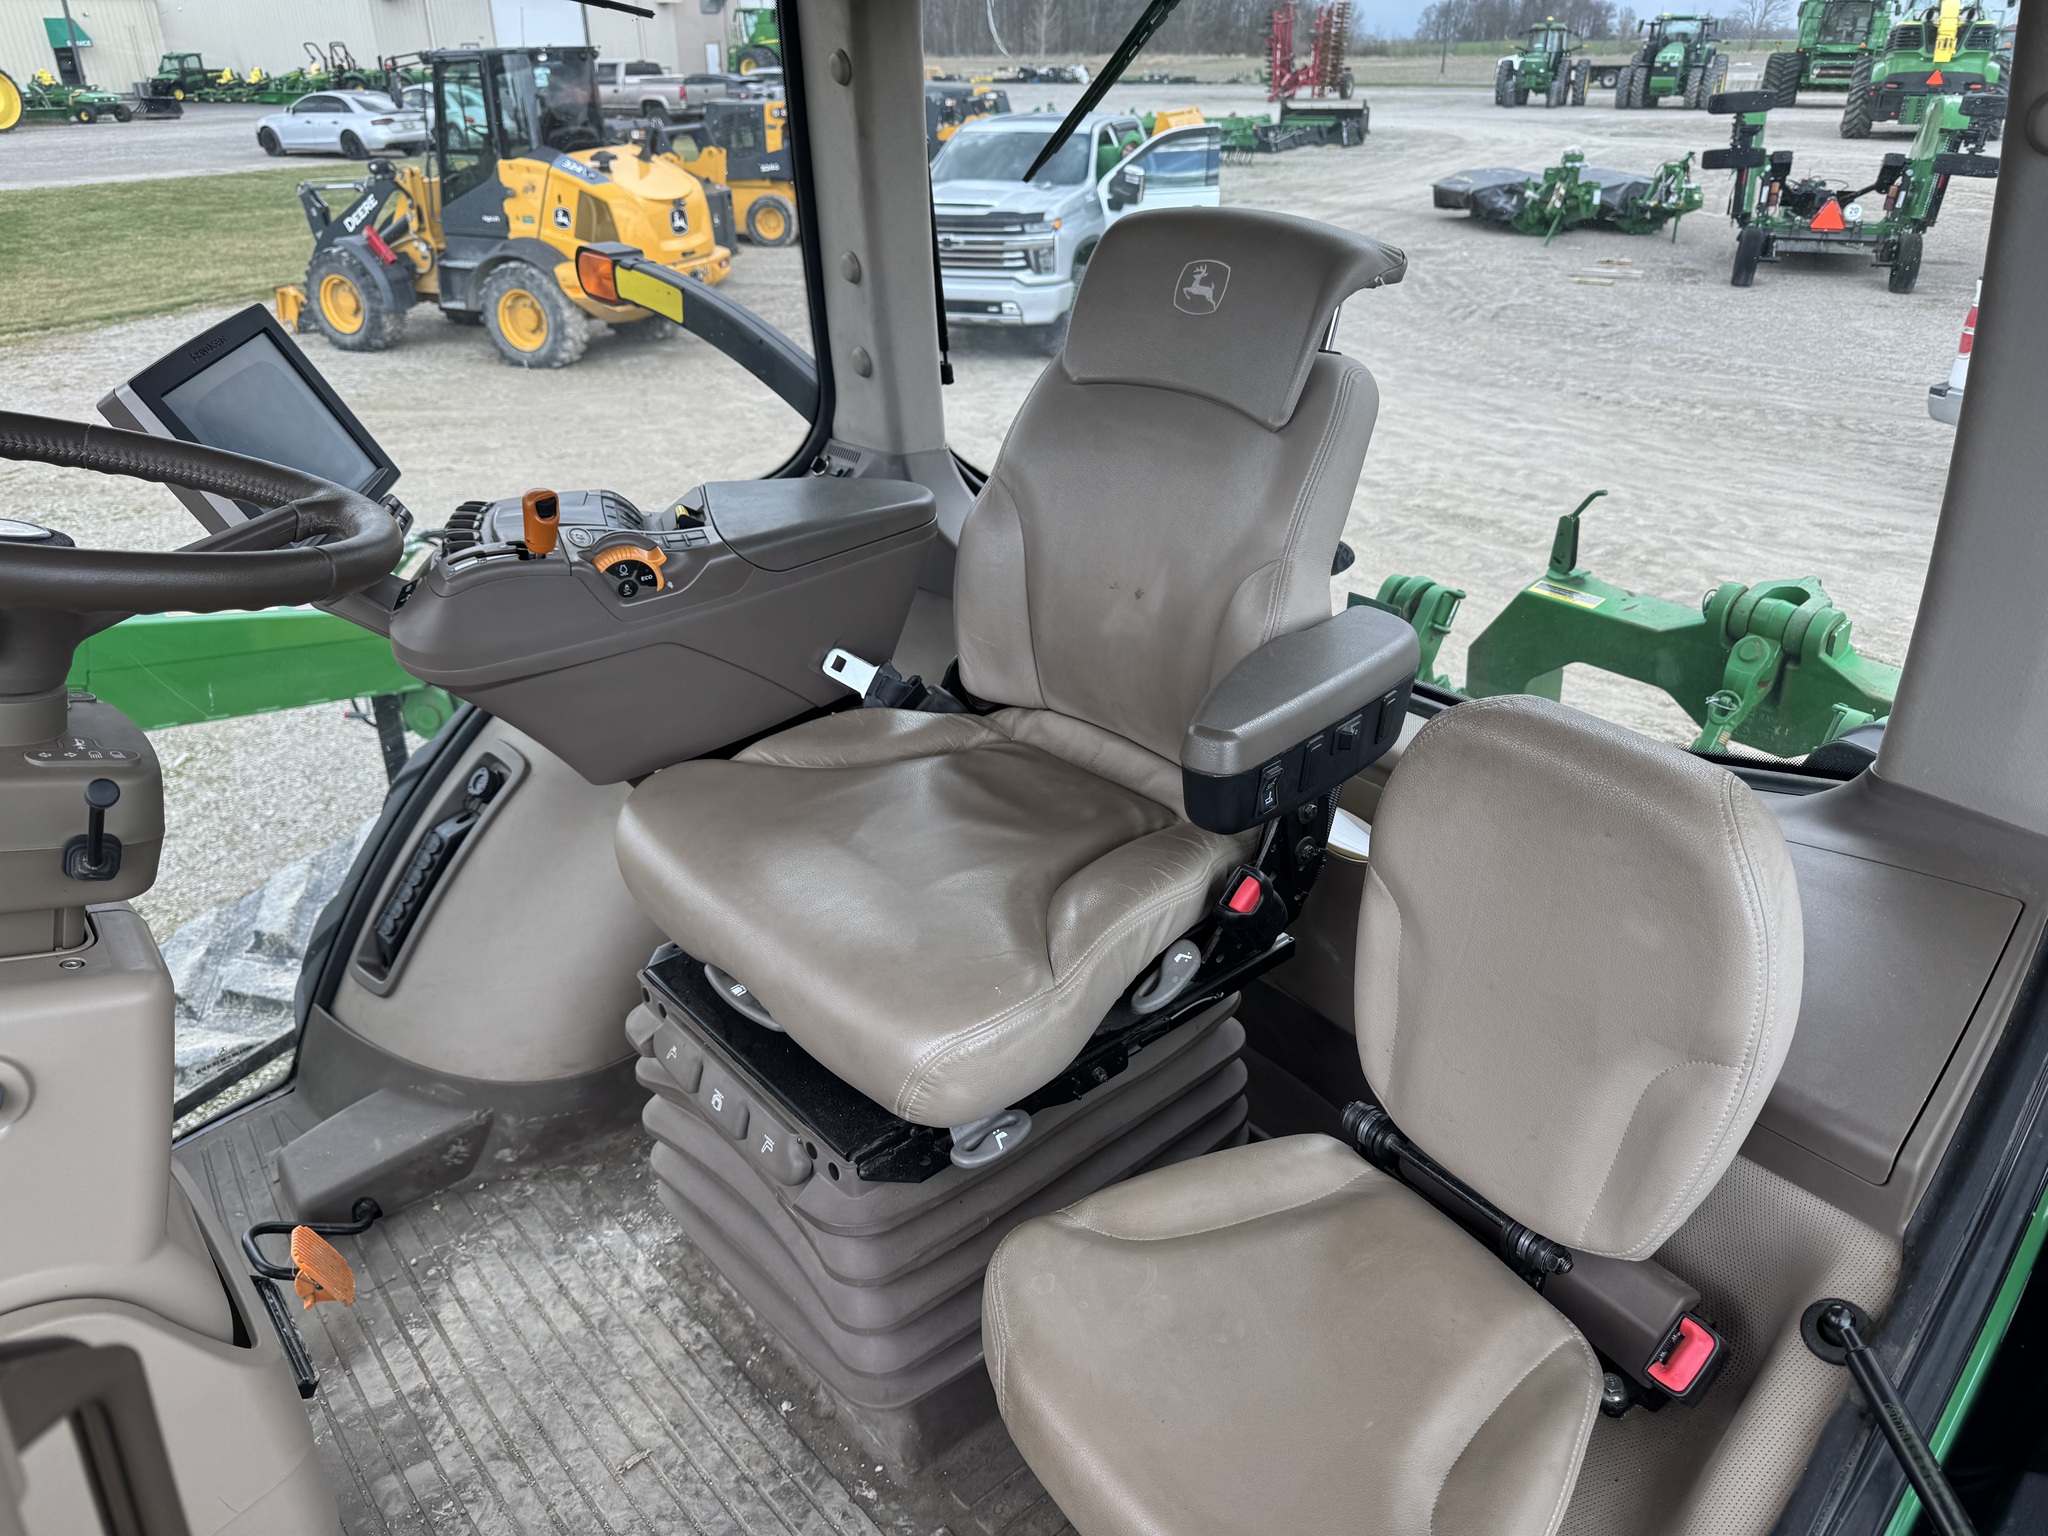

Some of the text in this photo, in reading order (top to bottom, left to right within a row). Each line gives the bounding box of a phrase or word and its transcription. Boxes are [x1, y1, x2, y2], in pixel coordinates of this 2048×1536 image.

[342, 193, 379, 233] DEERE
[1849, 206, 1860, 215] 20
[640, 574, 653, 582] ECO
